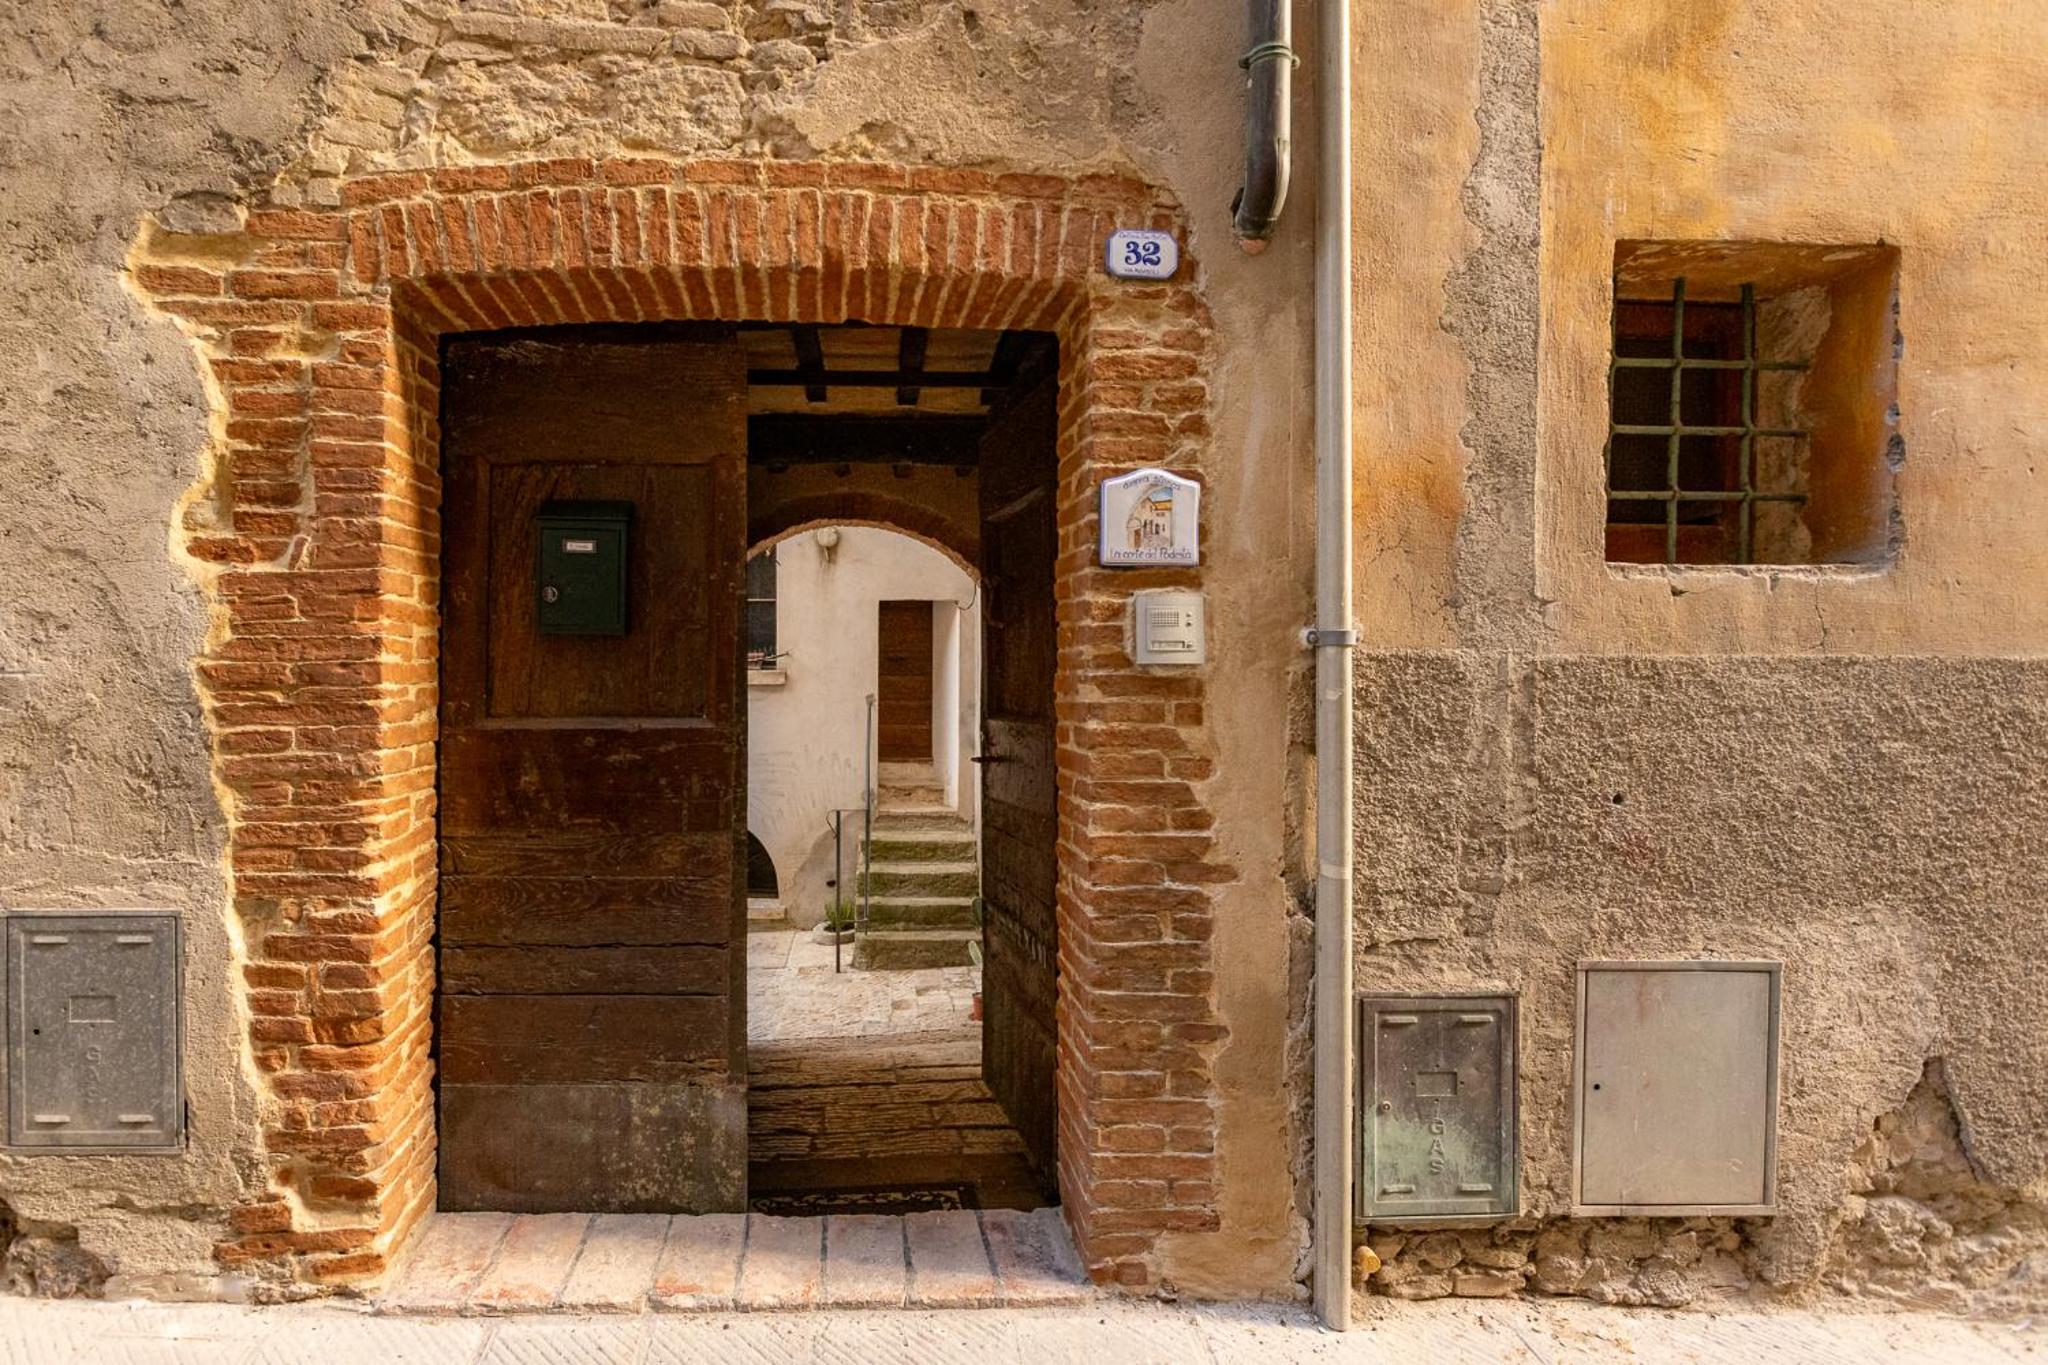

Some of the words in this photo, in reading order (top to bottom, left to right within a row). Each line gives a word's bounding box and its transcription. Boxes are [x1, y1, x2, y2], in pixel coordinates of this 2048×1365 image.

[1125, 241, 1161, 266] 32
[1123, 548, 1144, 559] corte
[1144, 547, 1157, 559] del
[1428, 1118, 1446, 1176] GAS
